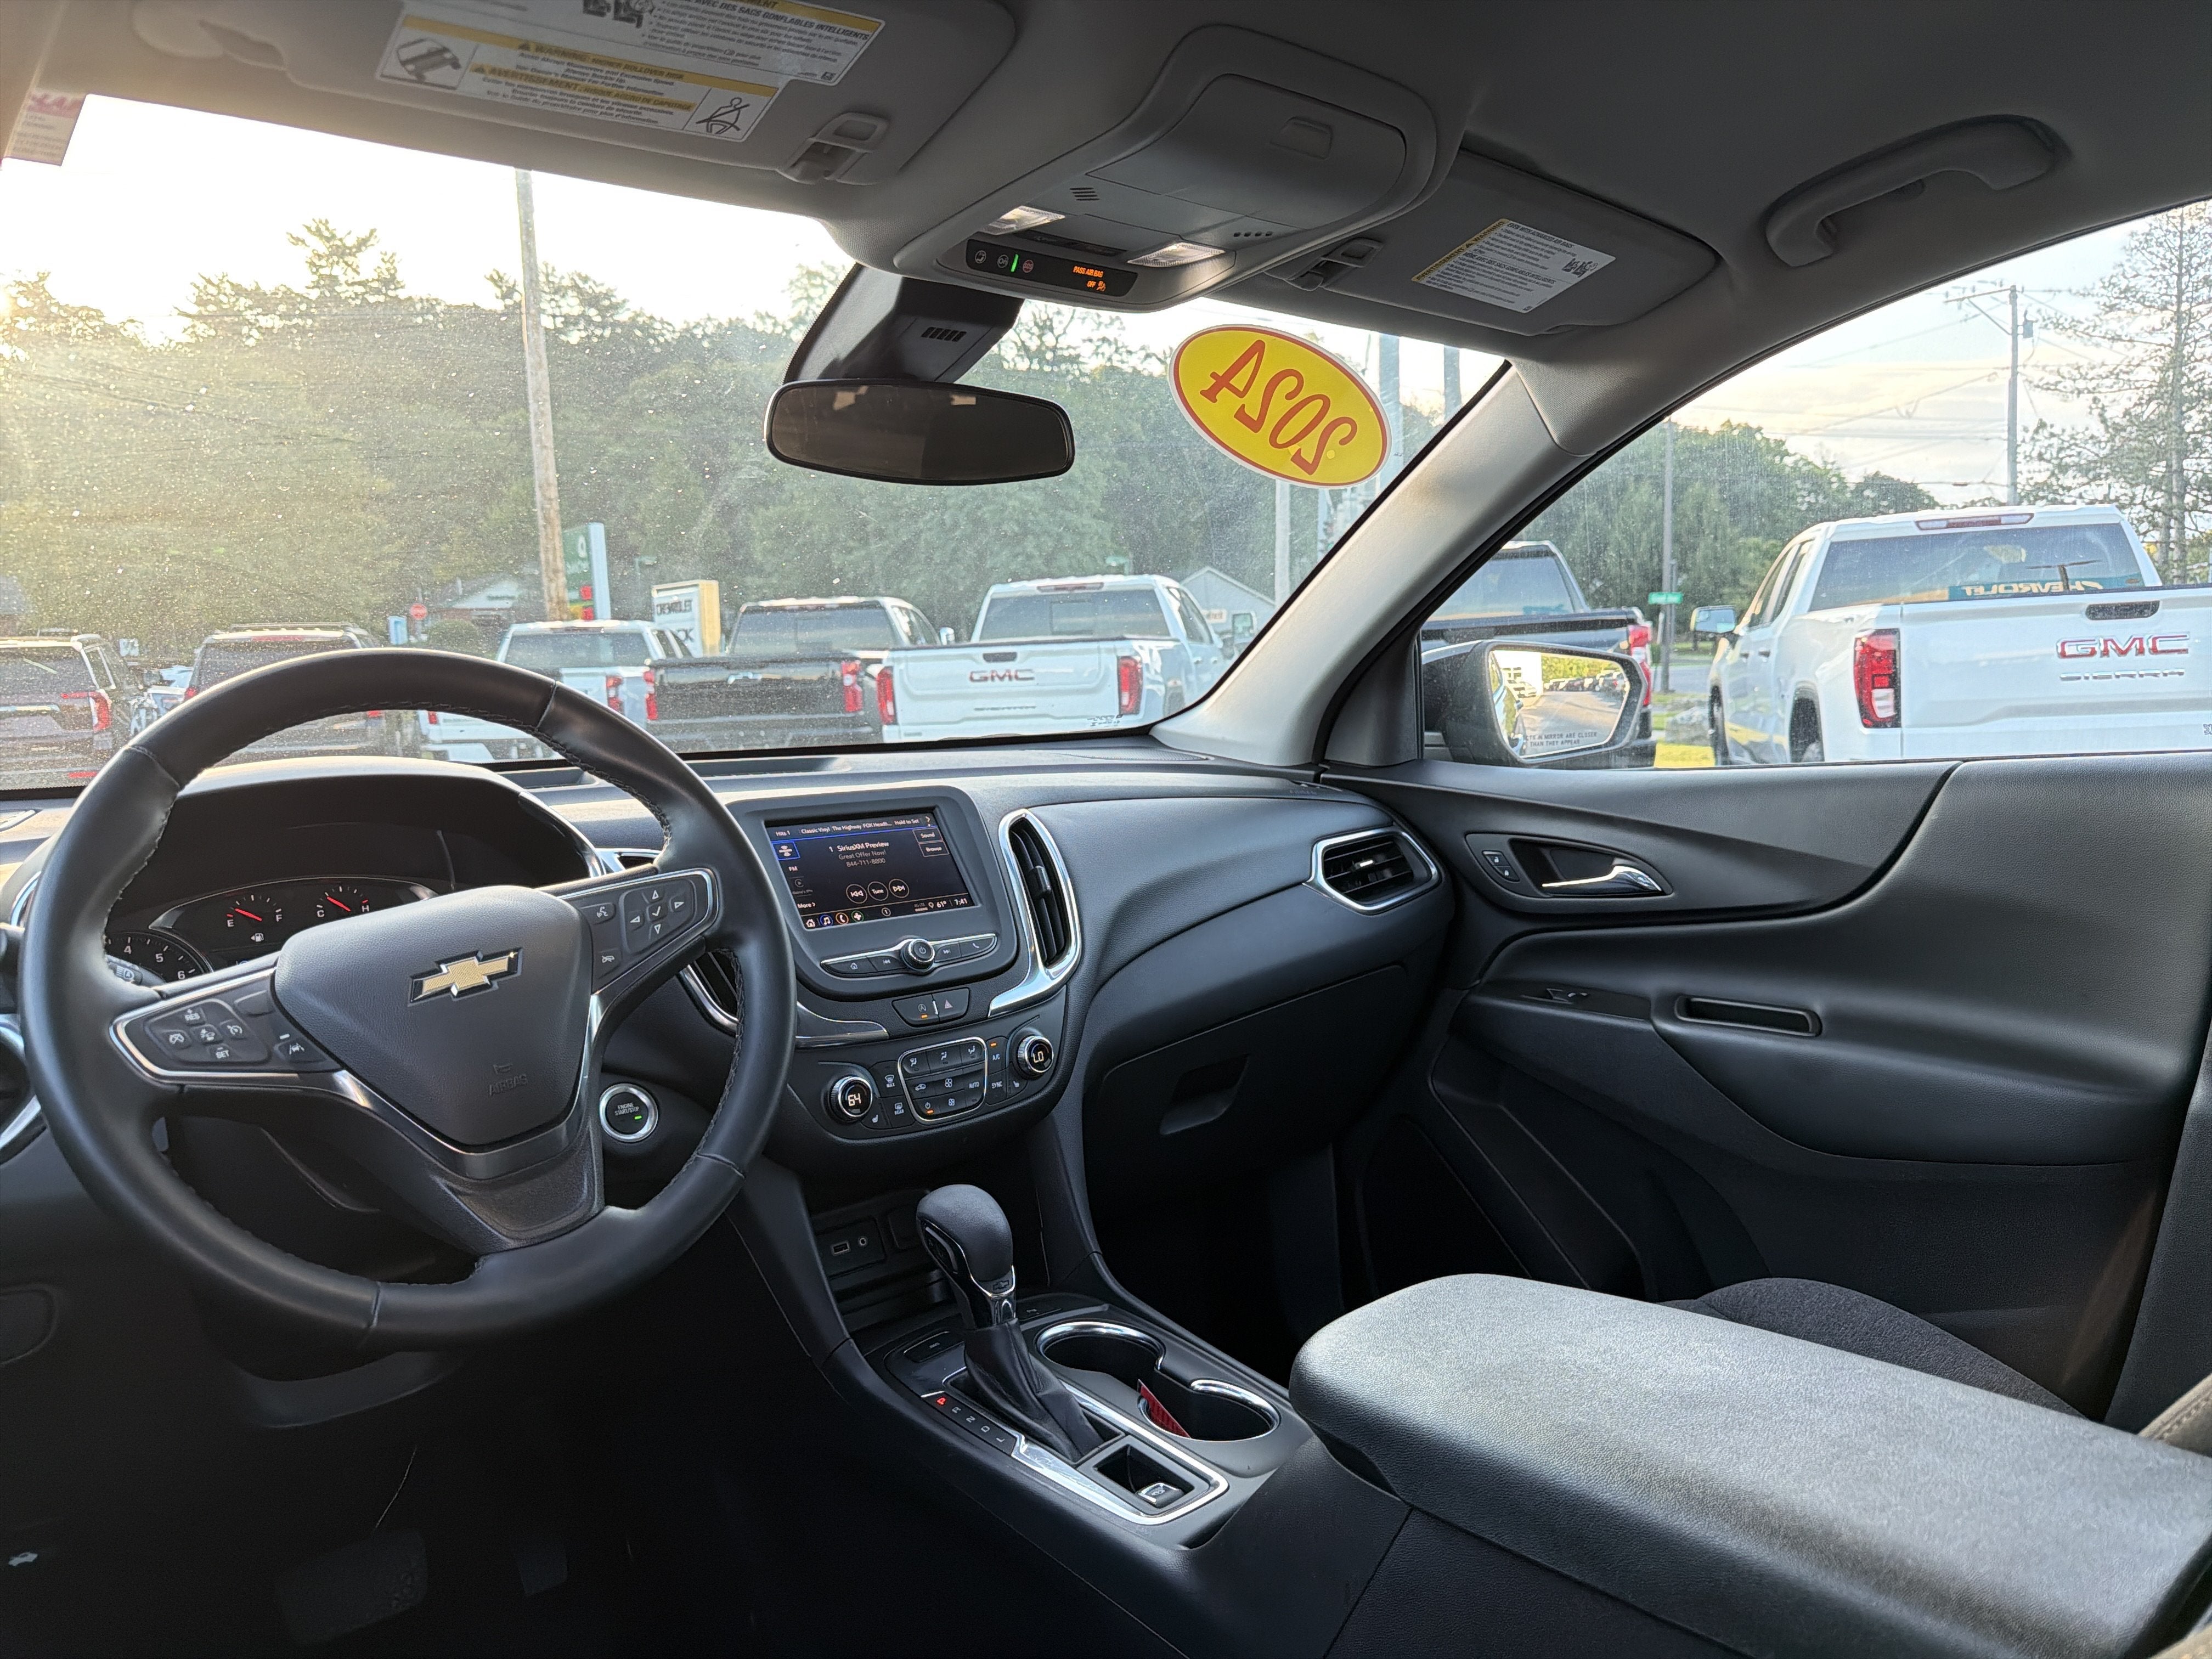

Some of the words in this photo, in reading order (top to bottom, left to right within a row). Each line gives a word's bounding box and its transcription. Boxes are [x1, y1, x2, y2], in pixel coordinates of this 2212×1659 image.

[718, 2, 738, 12] DES
[737, 6, 763, 16] SACS
[760, 12, 817, 28] GONFLABLES
[814, 24, 871, 40] INTELLIGENTS
[1472, 221, 1505, 242] WARNING
[1073, 266, 1085, 275] PASS
[2057, 632, 2190, 659] GMC
[969, 669, 1035, 682] GMC
[2060, 668, 2185, 681] SIERRA
[837, 843, 865, 851] SiriusXM
[846, 857, 886, 867] 844-711-8800
[124, 945, 132, 954] 4
[155, 953, 163, 962] 5
[178, 970, 185, 979] 6
[216, 1050, 229, 1059] SET
[991, 1081, 1003, 1089] SYNC
[848, 1093, 861, 1107] 64
[614, 1106, 640, 1116] START/STOP
[936, 1397, 946, 1405] P
